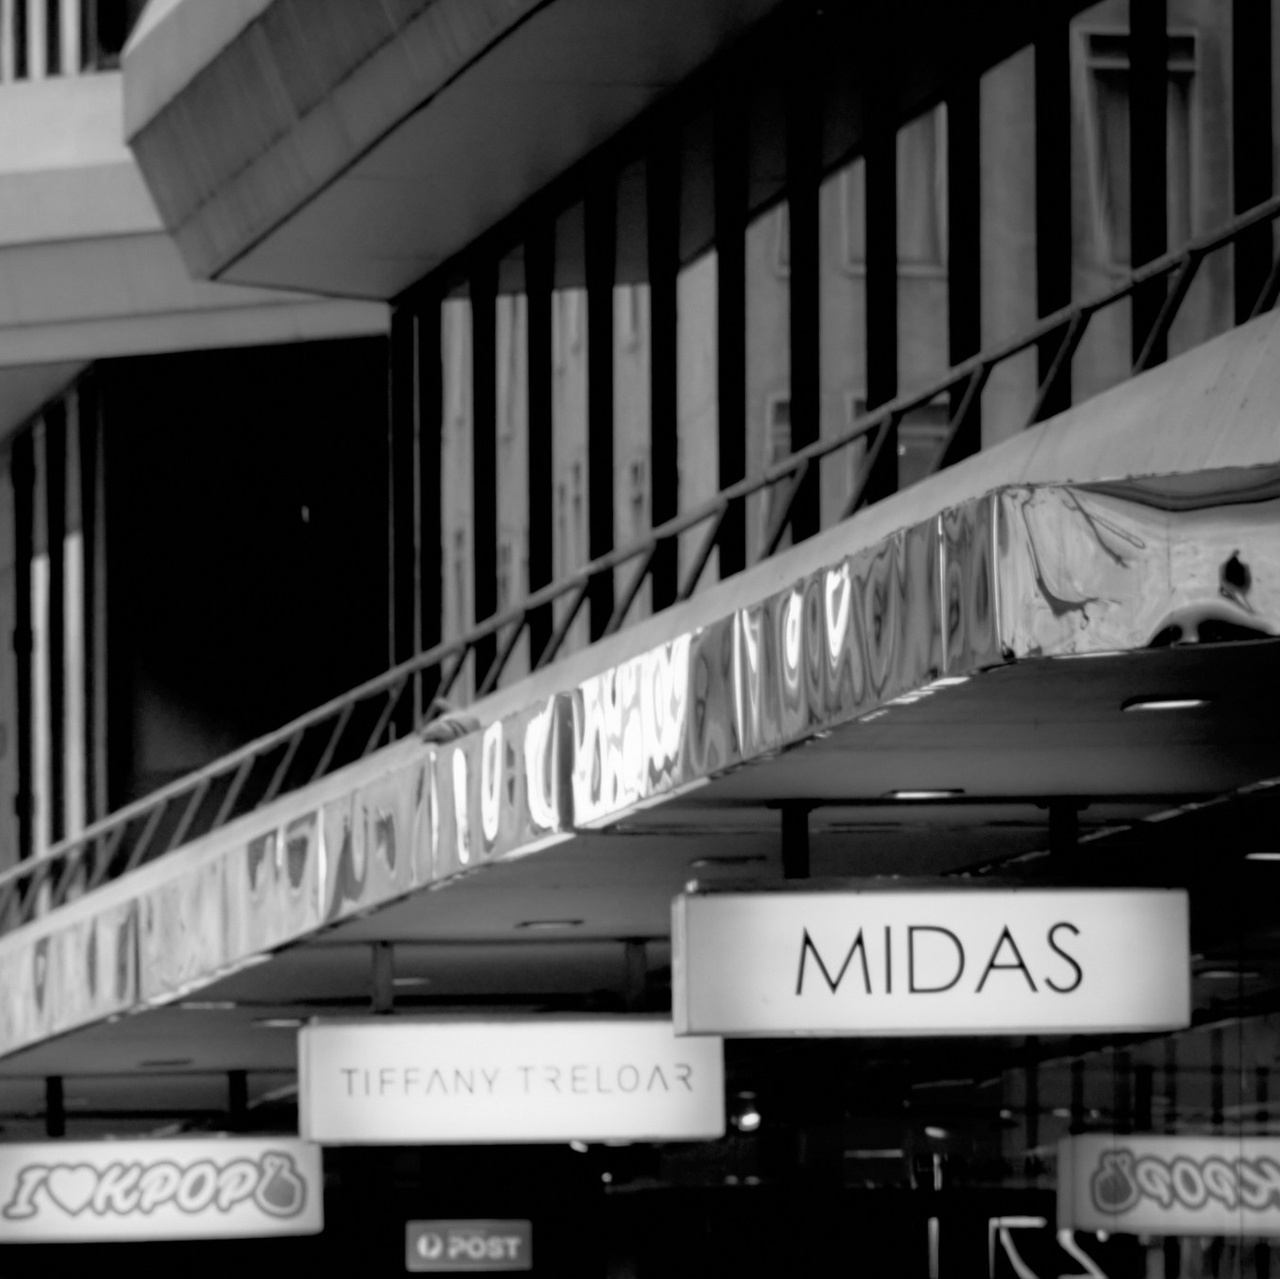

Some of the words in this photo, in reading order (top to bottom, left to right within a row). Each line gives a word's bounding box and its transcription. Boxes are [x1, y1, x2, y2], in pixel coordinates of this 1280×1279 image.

[795, 922, 1084, 996] MIDAS
[339, 1066, 501, 1097] TIFFANY
[516, 1063, 694, 1094] TRELOAR
[447, 1235, 523, 1260] POST
